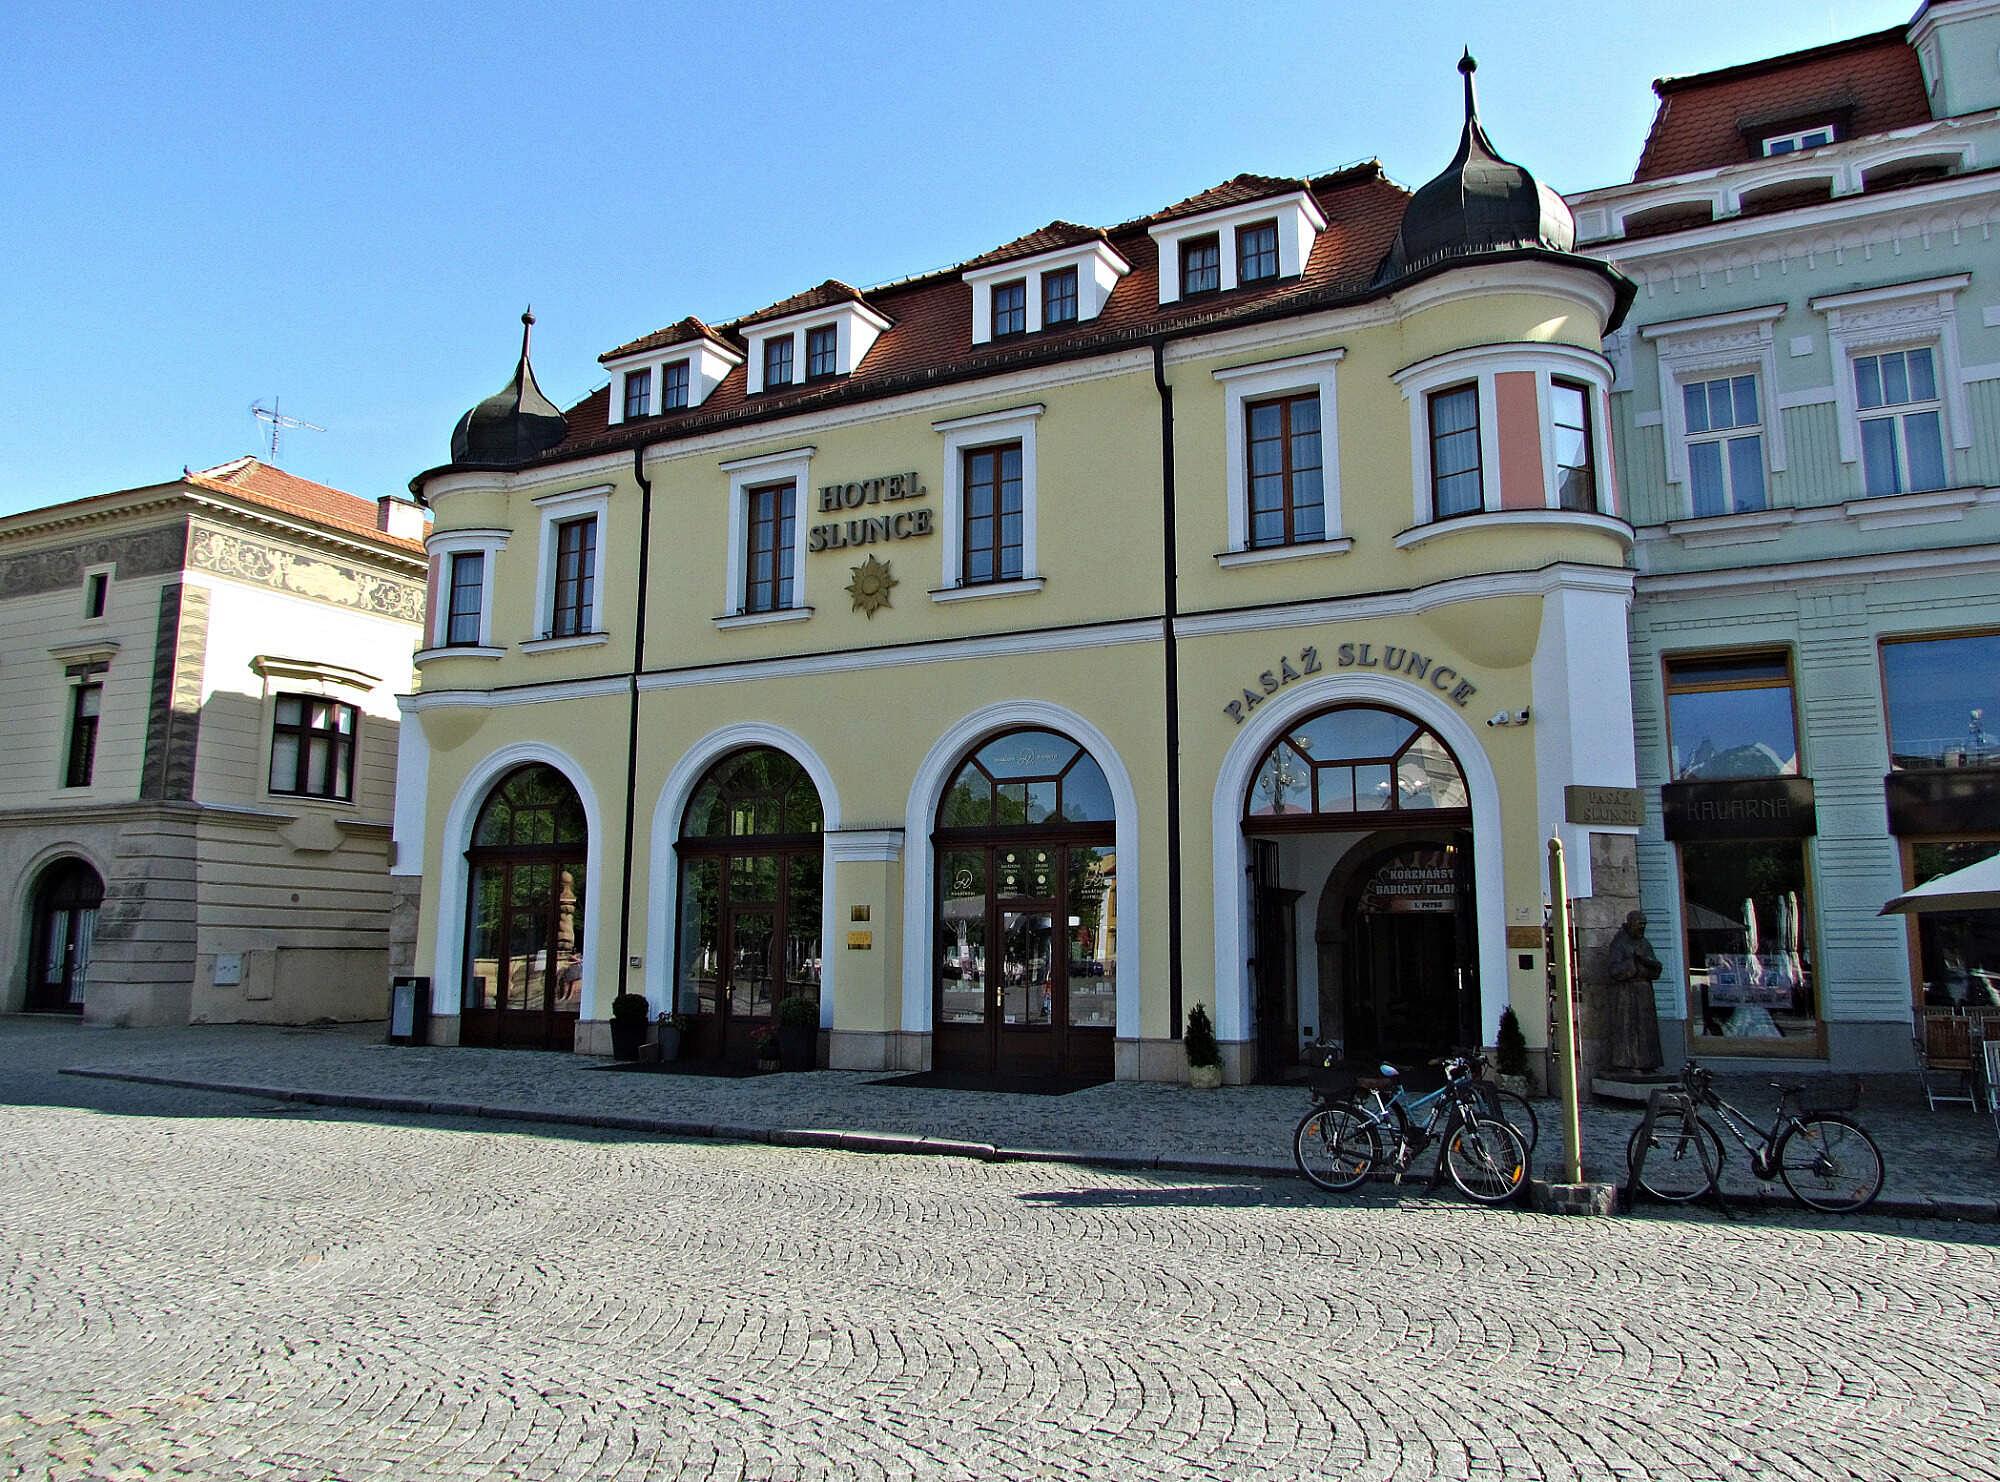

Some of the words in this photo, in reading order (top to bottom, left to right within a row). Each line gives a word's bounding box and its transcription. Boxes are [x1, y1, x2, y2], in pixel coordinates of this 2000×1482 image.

[818, 471, 927, 513] HOTEL
[809, 508, 933, 552] SLUNCE
[1223, 646, 1322, 724] PASÁŽ
[1338, 643, 1477, 707] SLUNCE
